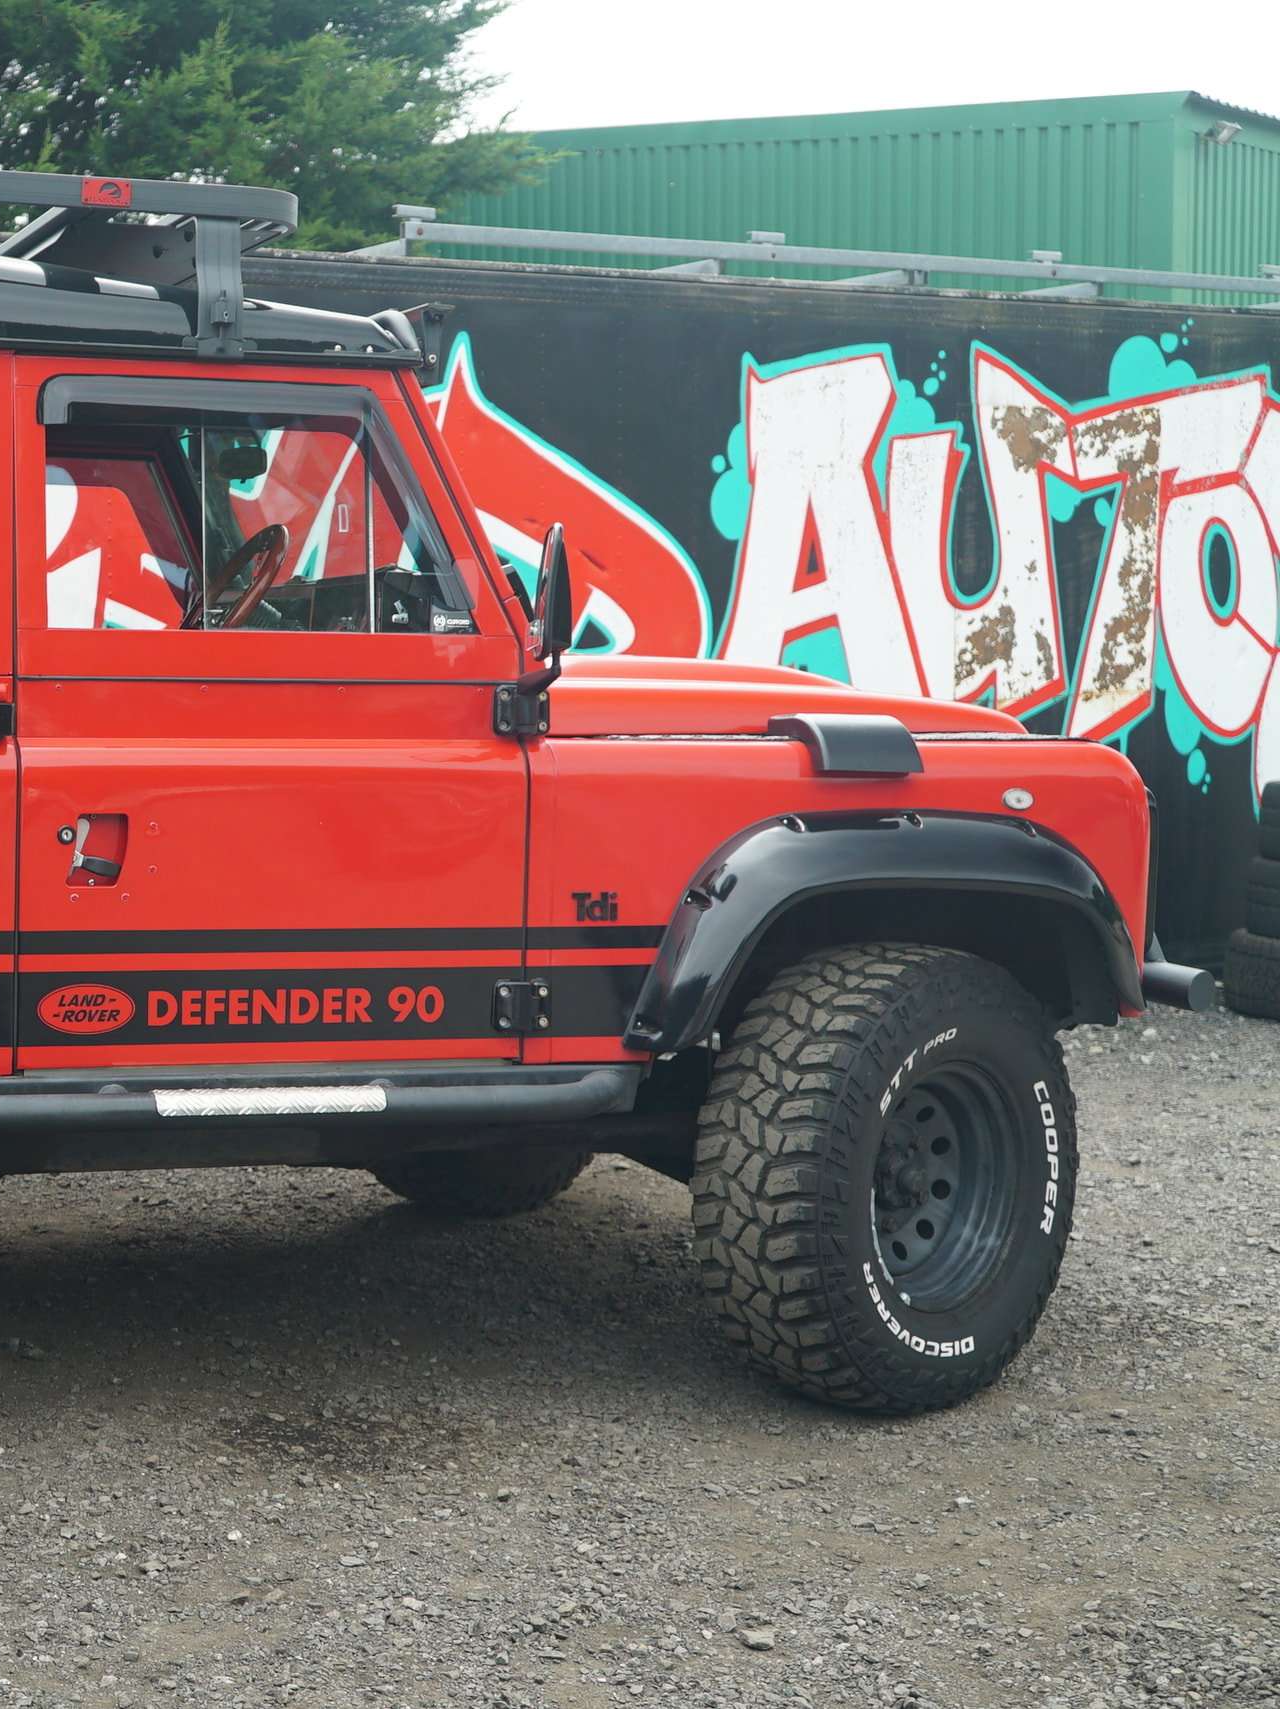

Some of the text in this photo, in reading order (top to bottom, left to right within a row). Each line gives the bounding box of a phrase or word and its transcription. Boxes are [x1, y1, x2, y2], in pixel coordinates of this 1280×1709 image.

[716, 345, 1280, 742] AUTO
[571, 891, 618, 922] Tdi
[58, 994, 105, 1007] LAND
[62, 1009, 120, 1022] ROVER
[147, 986, 444, 1026] DEFENDER 90
[879, 1027, 958, 1117] STT PRO
[1033, 1080, 1059, 1235] COOPER
[862, 1261, 975, 1357] DISCOVERER
